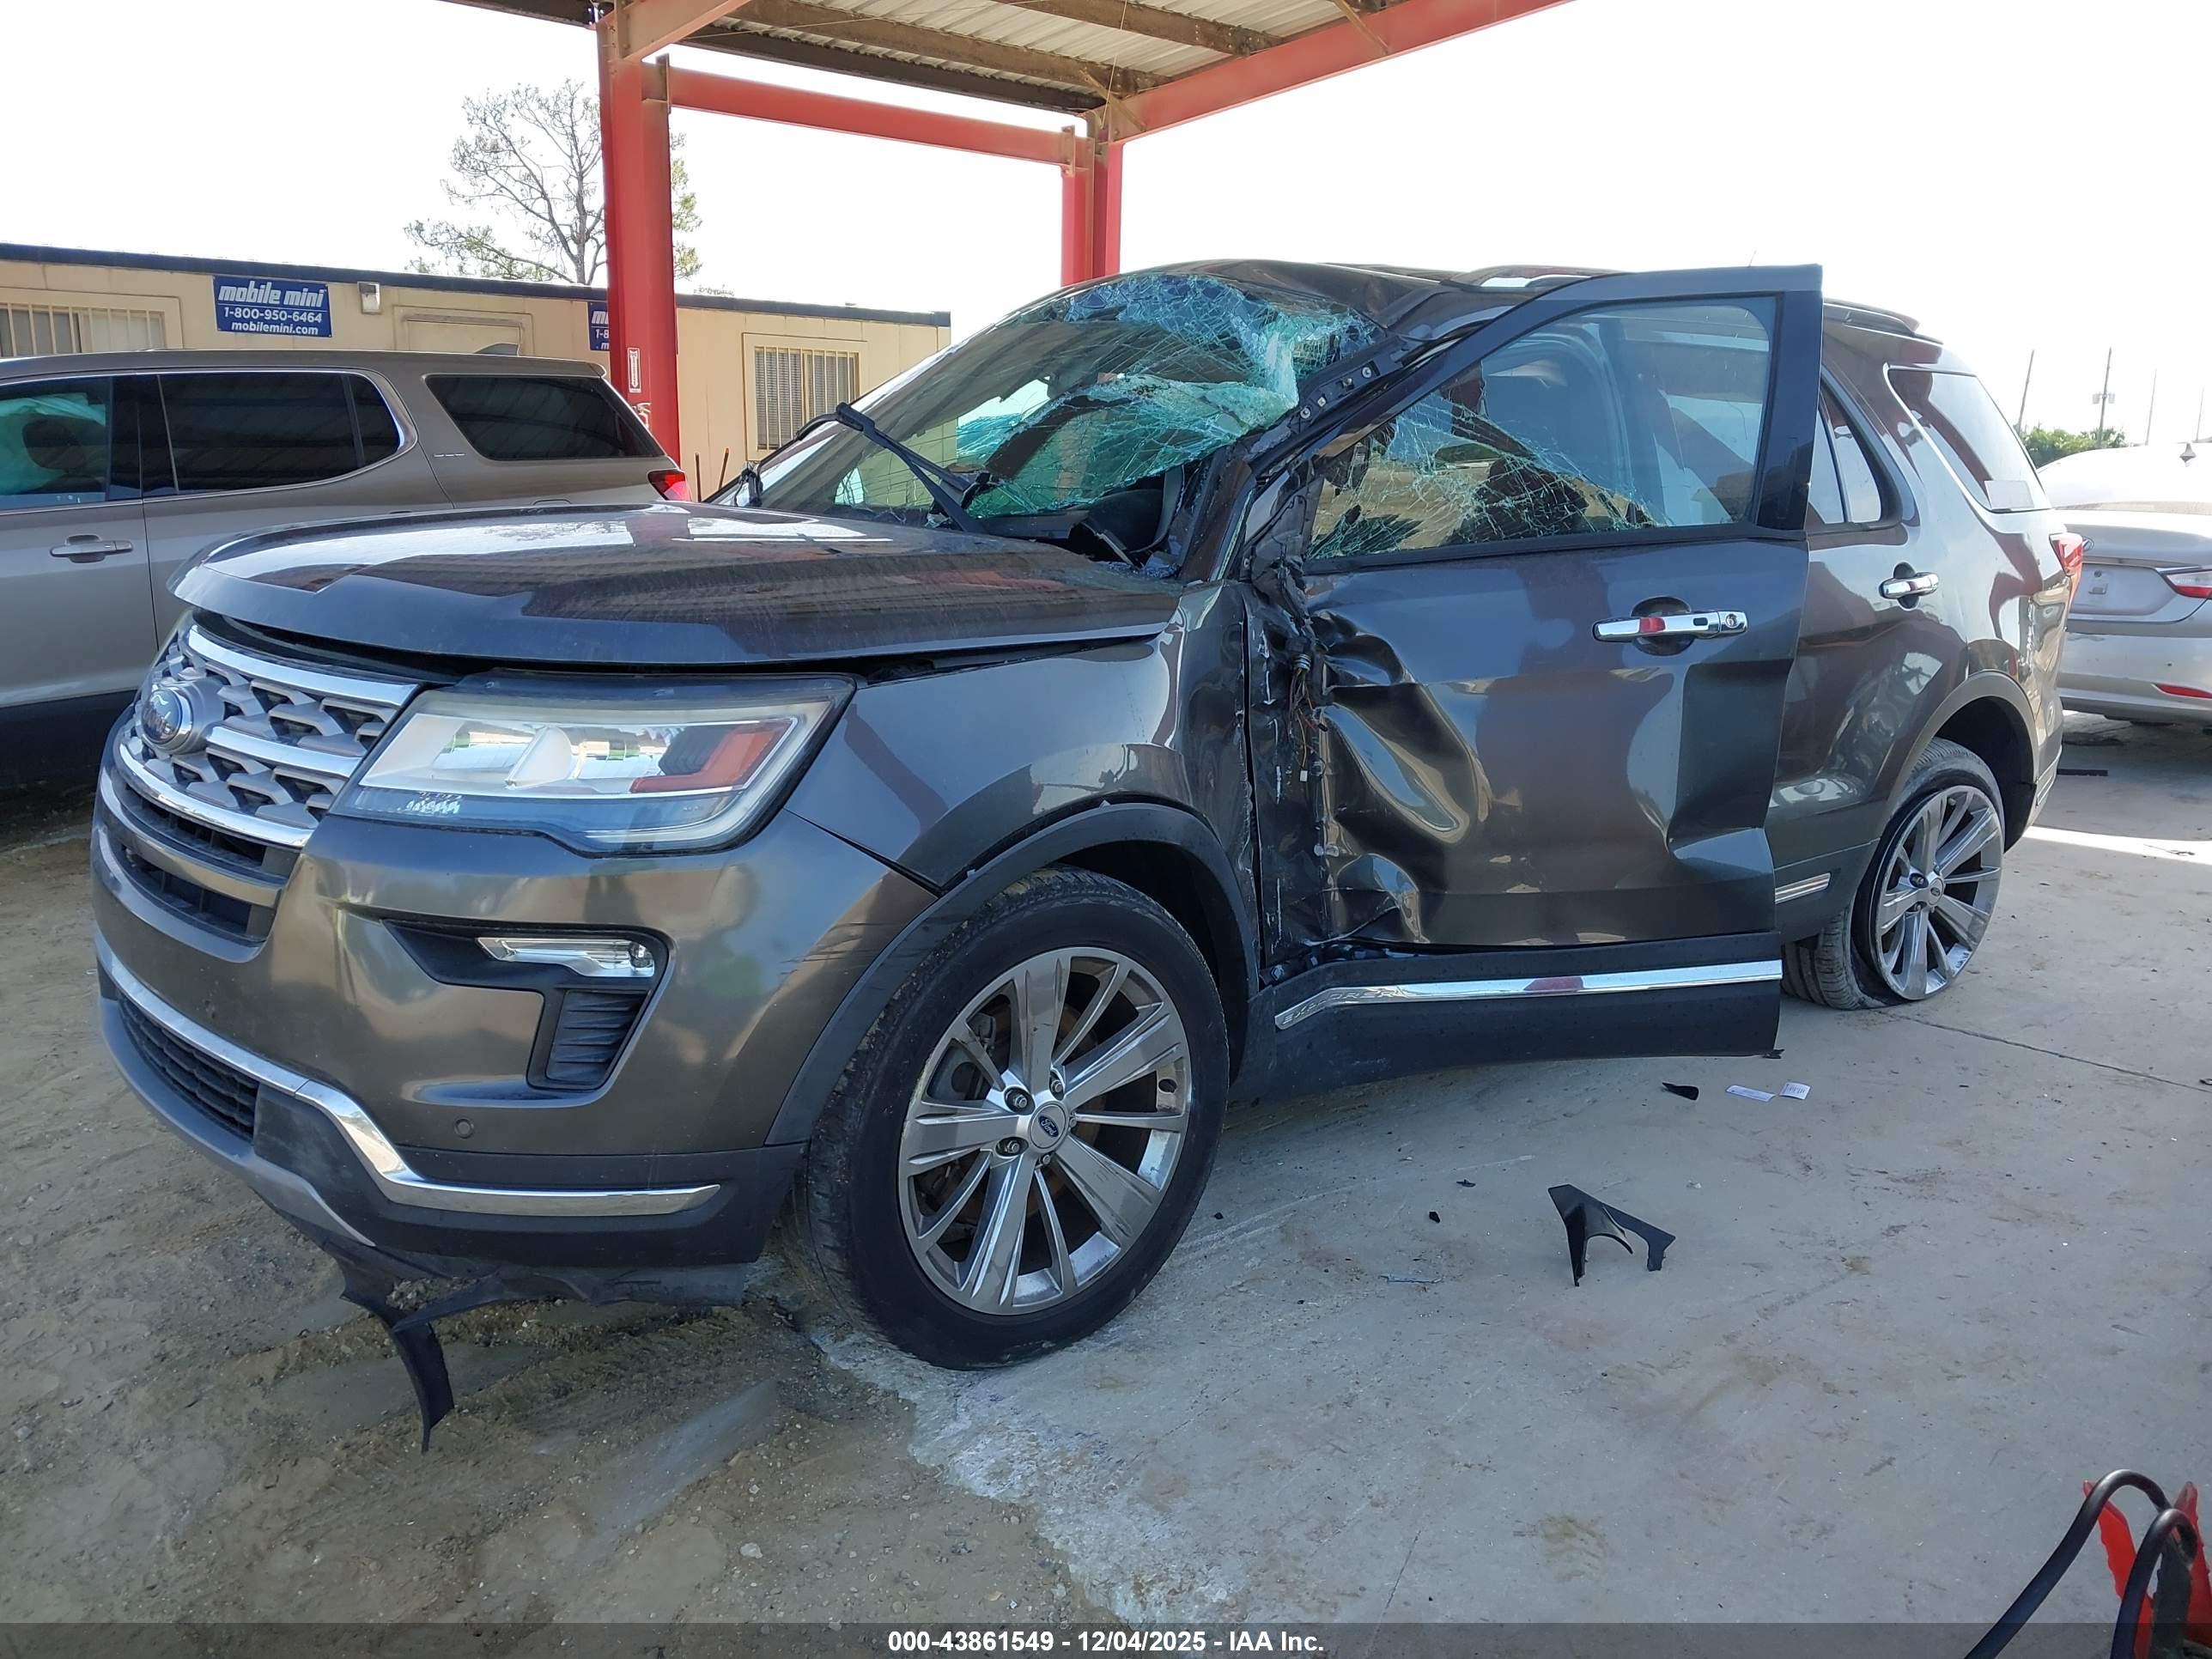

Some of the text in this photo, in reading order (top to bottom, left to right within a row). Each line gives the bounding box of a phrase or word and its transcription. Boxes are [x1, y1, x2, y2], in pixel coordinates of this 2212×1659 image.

[218, 281, 325, 307] mobile mini
[224, 307, 322, 323] 1-800-950-6464
[231, 321, 319, 335] mobilemini.com
[1041, 1118, 1057, 1135] Ford
